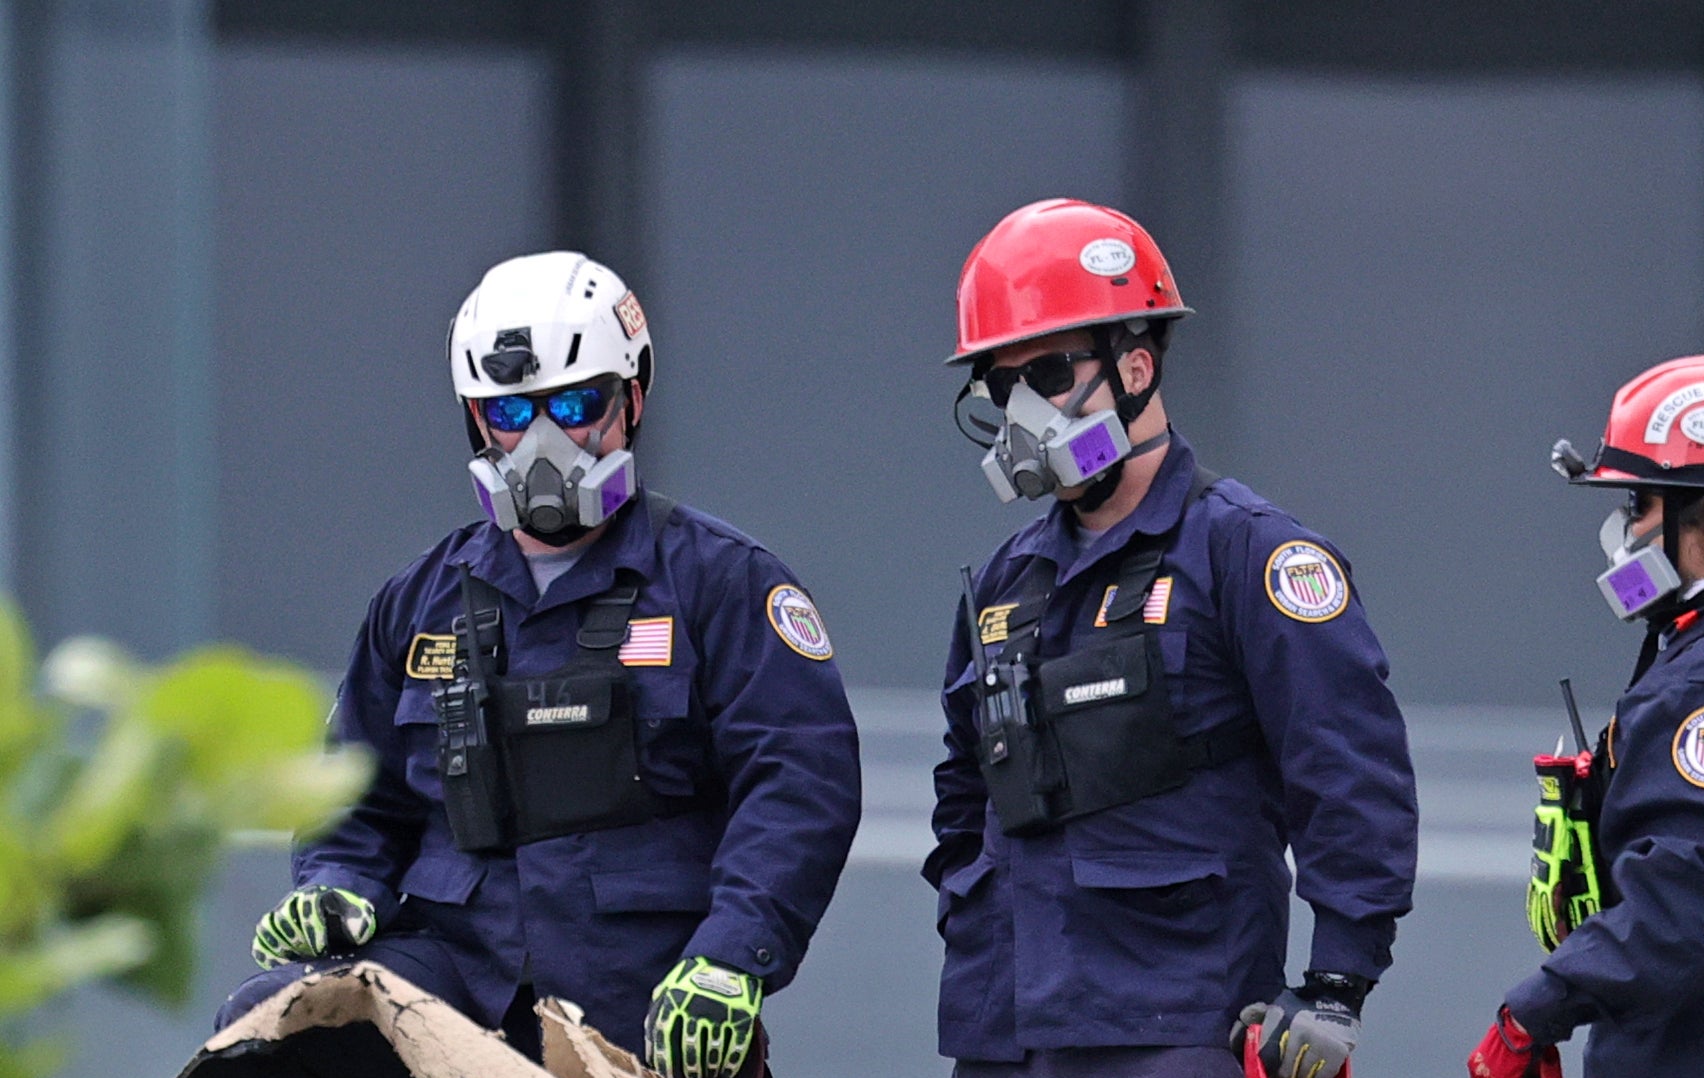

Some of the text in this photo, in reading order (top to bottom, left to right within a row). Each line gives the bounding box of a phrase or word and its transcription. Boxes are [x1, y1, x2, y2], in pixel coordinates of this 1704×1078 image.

[1651, 387, 1704, 433] RESCUE
[1064, 678, 1125, 701] CONTERRA
[526, 705, 588, 721] CONTERRA
